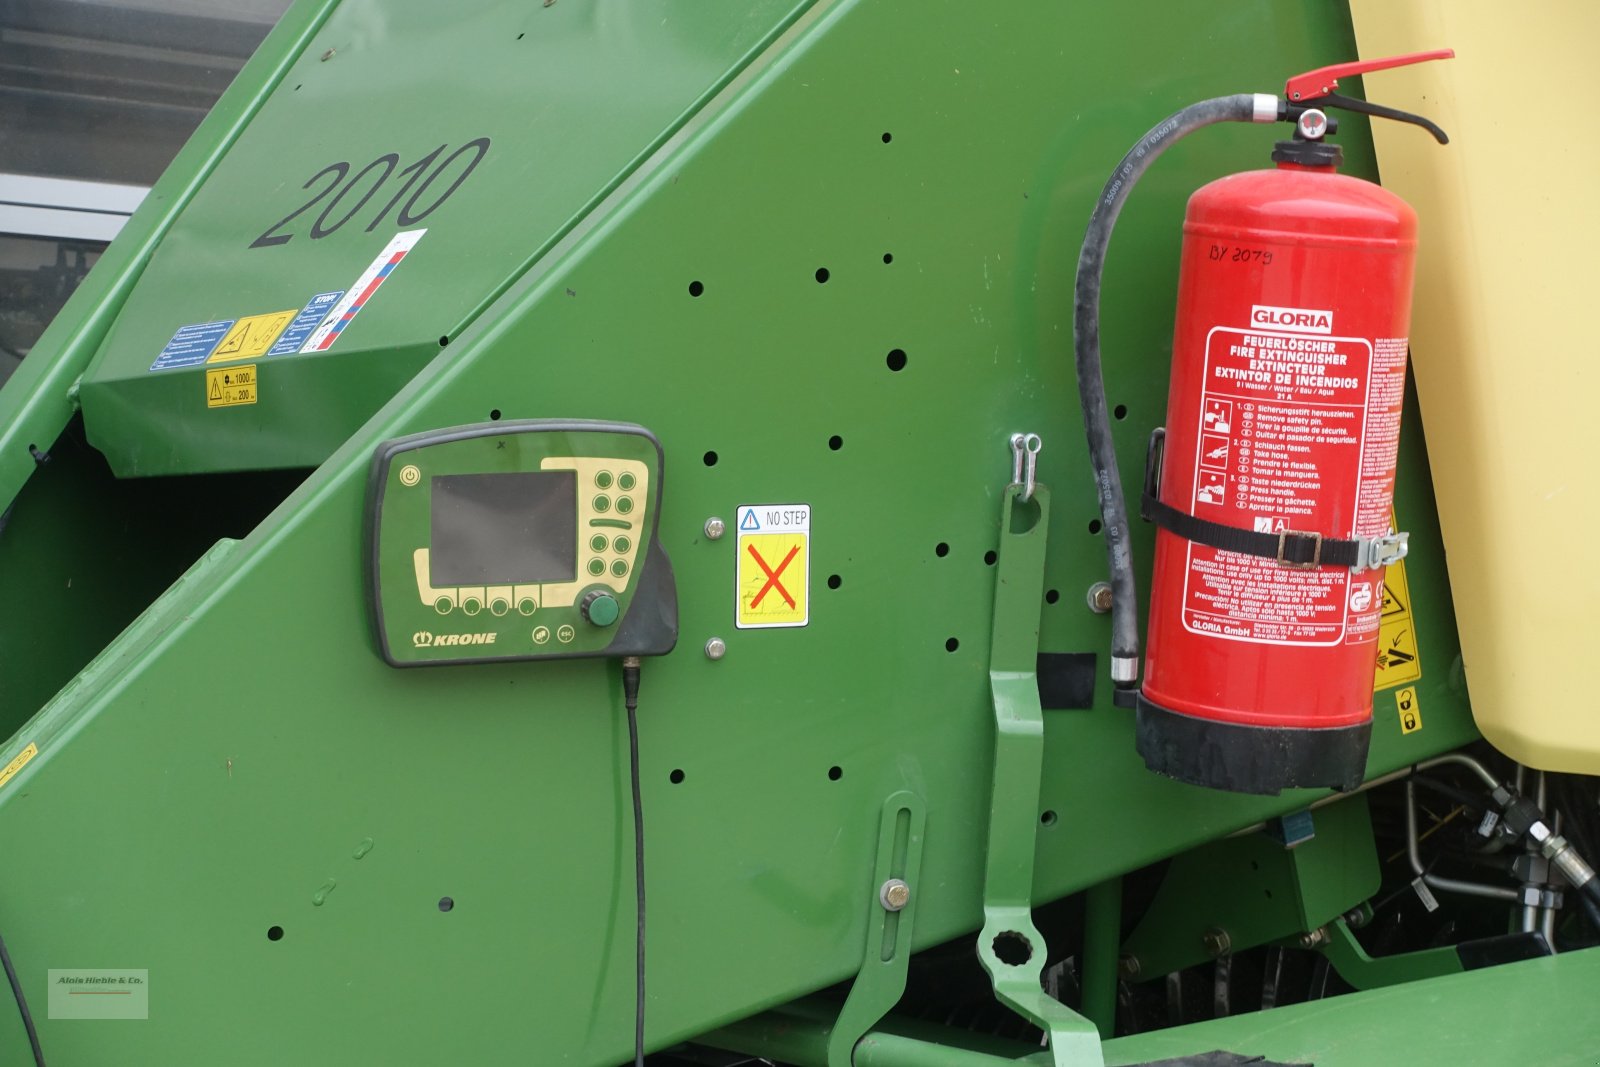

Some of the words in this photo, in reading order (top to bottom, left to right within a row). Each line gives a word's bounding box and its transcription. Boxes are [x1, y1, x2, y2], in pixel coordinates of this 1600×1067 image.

[248, 137, 491, 249] 2010
[1104, 179, 1122, 206] 35009
[1253, 309, 1330, 329] GLORIA
[1243, 335, 1336, 353] FEUERLÖSCHER
[1230, 345, 1255, 358] FIRE
[1259, 348, 1348, 365] EXTINGUISHER
[1249, 360, 1325, 376] EXTINCTEUR
[235, 372, 250, 384] 1000
[1215, 366, 1271, 383] EXTINTOR
[1275, 373, 1291, 385] DE
[1295, 375, 1358, 389] INCENDIOS
[238, 389, 249, 400] 200
[1245, 382, 1268, 390] Wasser
[1274, 385, 1294, 393] Water
[1300, 387, 1312, 395] Eau
[1318, 388, 1334, 396] Agua
[1257, 405, 1310, 416] Sicherungsstift
[1311, 409, 1355, 418] herausziehen.
[1257, 414, 1286, 423] Remove
[1286, 415, 1309, 425] safety
[1256, 422, 1272, 430] Tirer
[1273, 423, 1280, 431] la
[1281, 424, 1310, 433] goupille
[1321, 426, 1348, 435] sécurité.
[1255, 431, 1277, 440] Quitar
[1286, 433, 1315, 442] pasador
[1316, 435, 1325, 443] de
[1326, 436, 1357, 445] seguridad.
[1254, 441, 1286, 451] Schlauch
[1286, 444, 1311, 453] fassen.
[1253, 450, 1269, 458] Take
[1271, 451, 1290, 460] hose.
[1252, 458, 1281, 467] Prendre
[1290, 460, 1317, 470] flexible.
[1252, 467, 1274, 476] Tomar
[1283, 470, 1320, 479] manguera.
[1251, 477, 1269, 485] Taste
[1270, 479, 1321, 489] niederdrücken
[1250, 485, 1269, 494] Press
[1270, 487, 1296, 496] handle.
[1249, 494, 1275, 503] Presser
[1248, 503, 1275, 512] Apretar
[1276, 504, 1283, 512] la
[1284, 505, 1313, 515] palanca.
[766, 511, 781, 526] NO
[783, 510, 807, 526] STEP
[1274, 519, 1285, 532] A
[1192, 558, 1218, 567] Attention
[1274, 568, 1289, 576] fires
[1290, 570, 1319, 578] involving
[1319, 571, 1345, 579] electrical
[1202, 573, 1230, 583] Attention
[1230, 578, 1246, 586] avec
[1238, 572, 1252, 580] only
[1217, 588, 1233, 596] Tenir
[1244, 586, 1269, 594] tension
[1274, 603, 1305, 611] presencia
[1228, 610, 1257, 619] distancia
[1192, 620, 1222, 633] GLORIA
[1223, 625, 1251, 637] GmbH
[433, 632, 498, 647] KRONE
